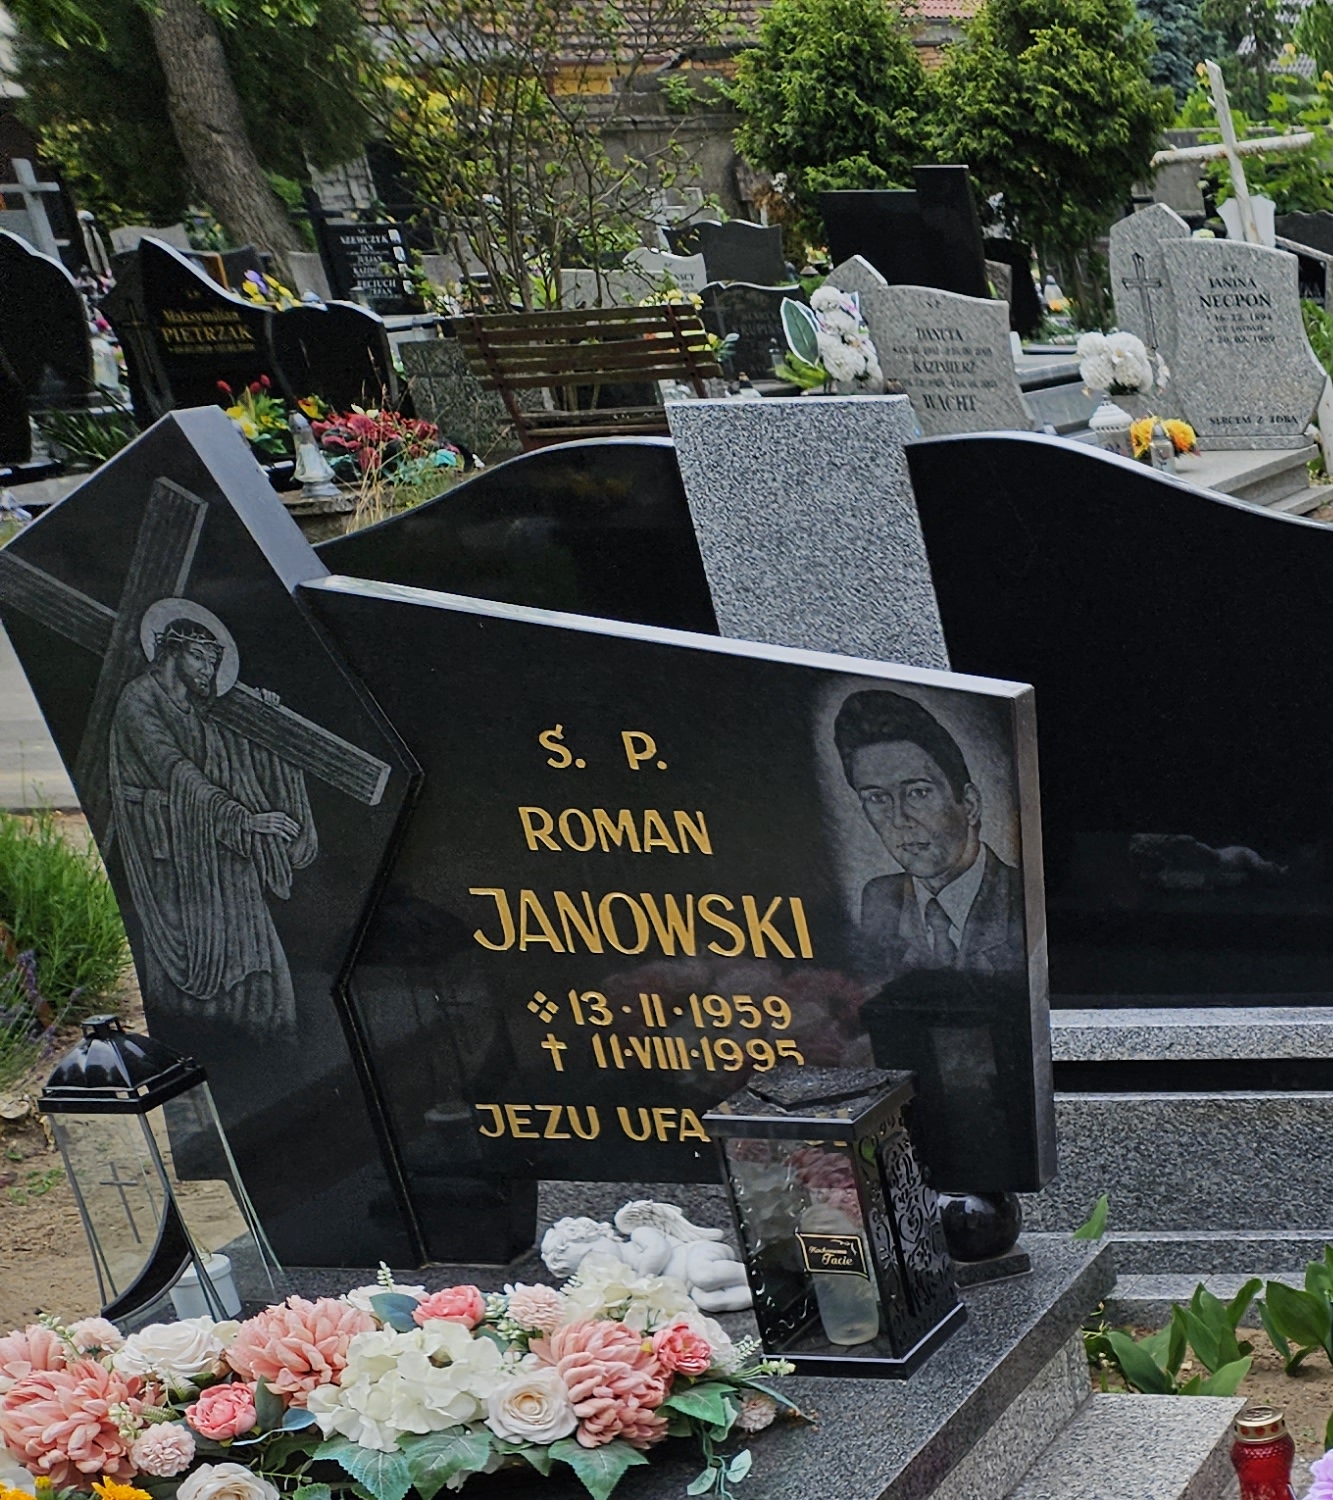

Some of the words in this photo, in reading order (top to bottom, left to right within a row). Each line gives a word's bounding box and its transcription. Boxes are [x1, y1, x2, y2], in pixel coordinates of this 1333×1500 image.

[161, 326, 254, 343] PIETRZAK
[539, 724, 587, 769] Ś.
[621, 730, 668, 771] P.
[518, 806, 713, 855] ROMAN
[468, 887, 814, 959] JANOWSKI
[475, 1103, 600, 1141] JEZU
[616, 1106, 712, 1142] UFA
[821, 1252, 853, 1266] Tacie
